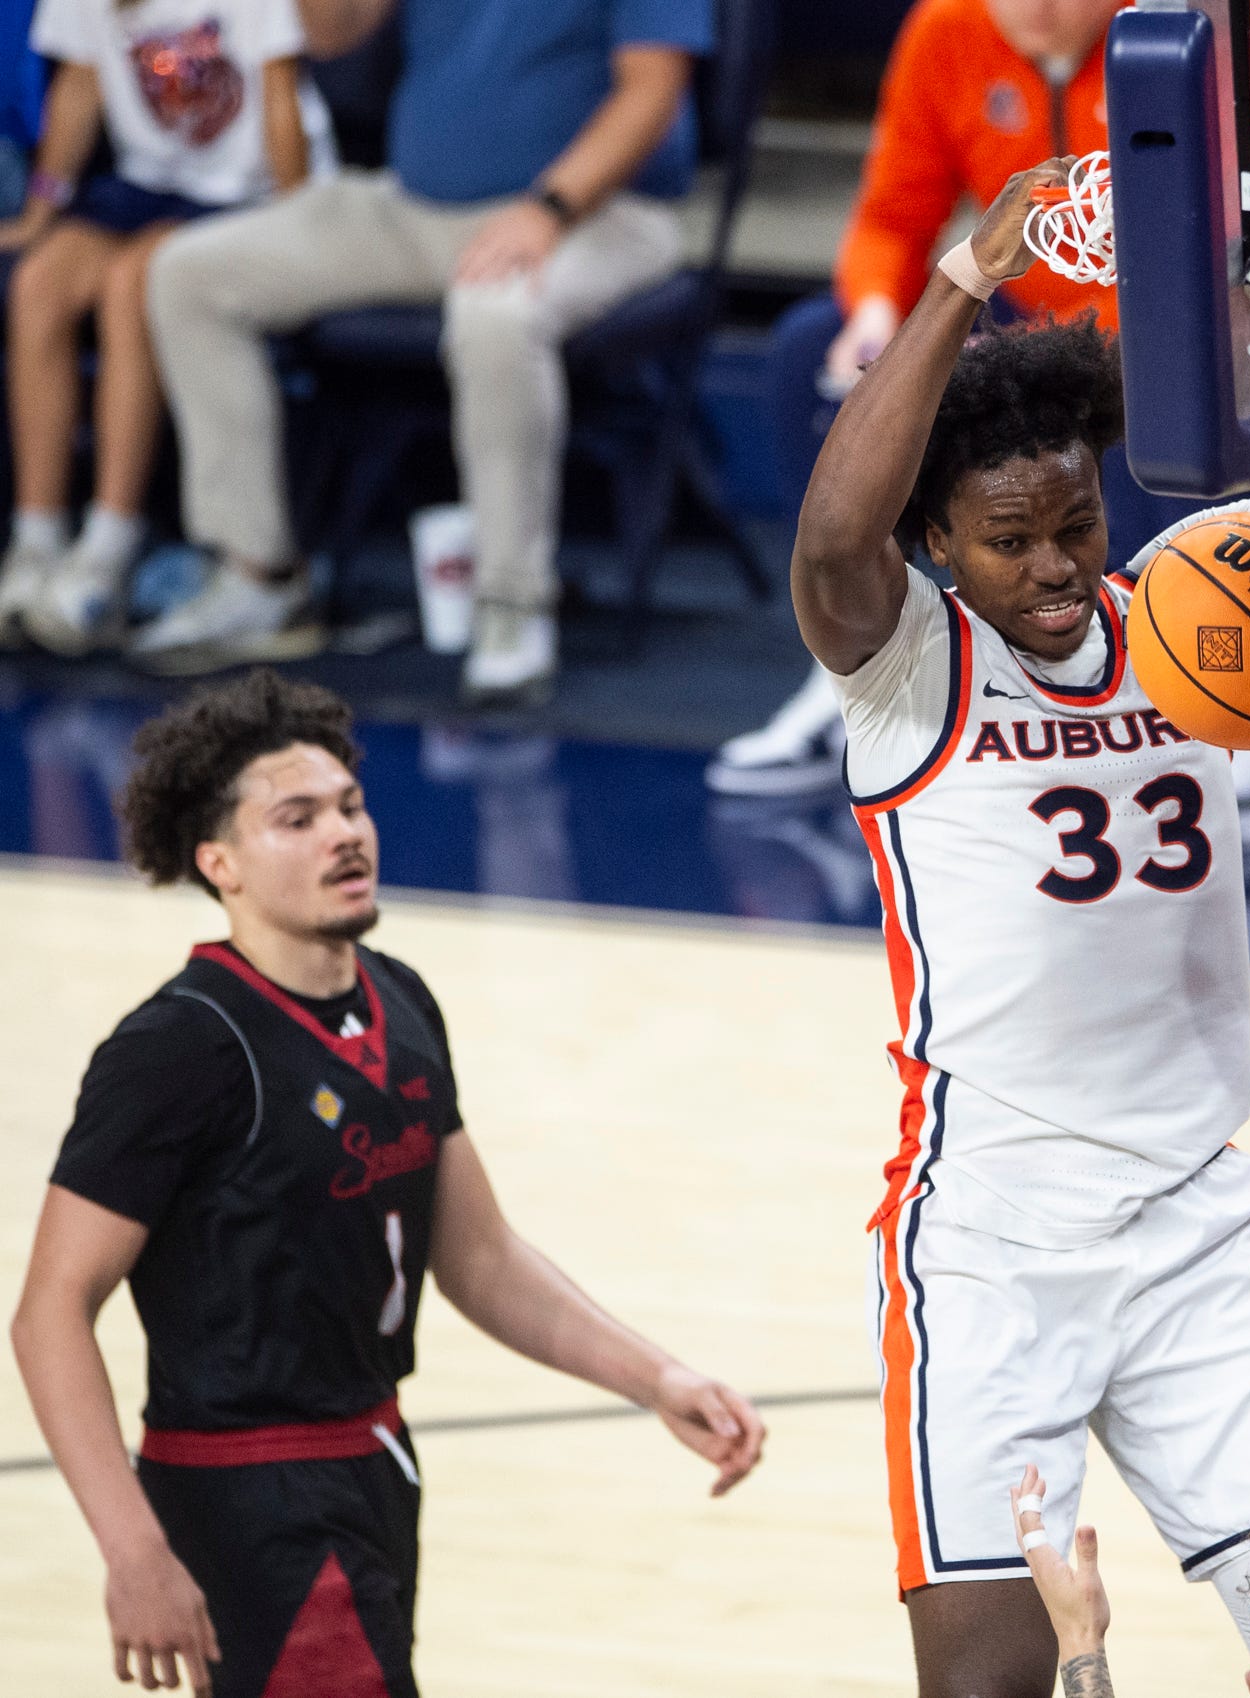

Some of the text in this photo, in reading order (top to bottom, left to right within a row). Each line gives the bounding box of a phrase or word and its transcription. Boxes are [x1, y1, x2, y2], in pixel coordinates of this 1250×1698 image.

[1205, 633, 1234, 660] NIT
[966, 708, 1194, 762] AUBUR
[1027, 772, 1213, 904] 33
